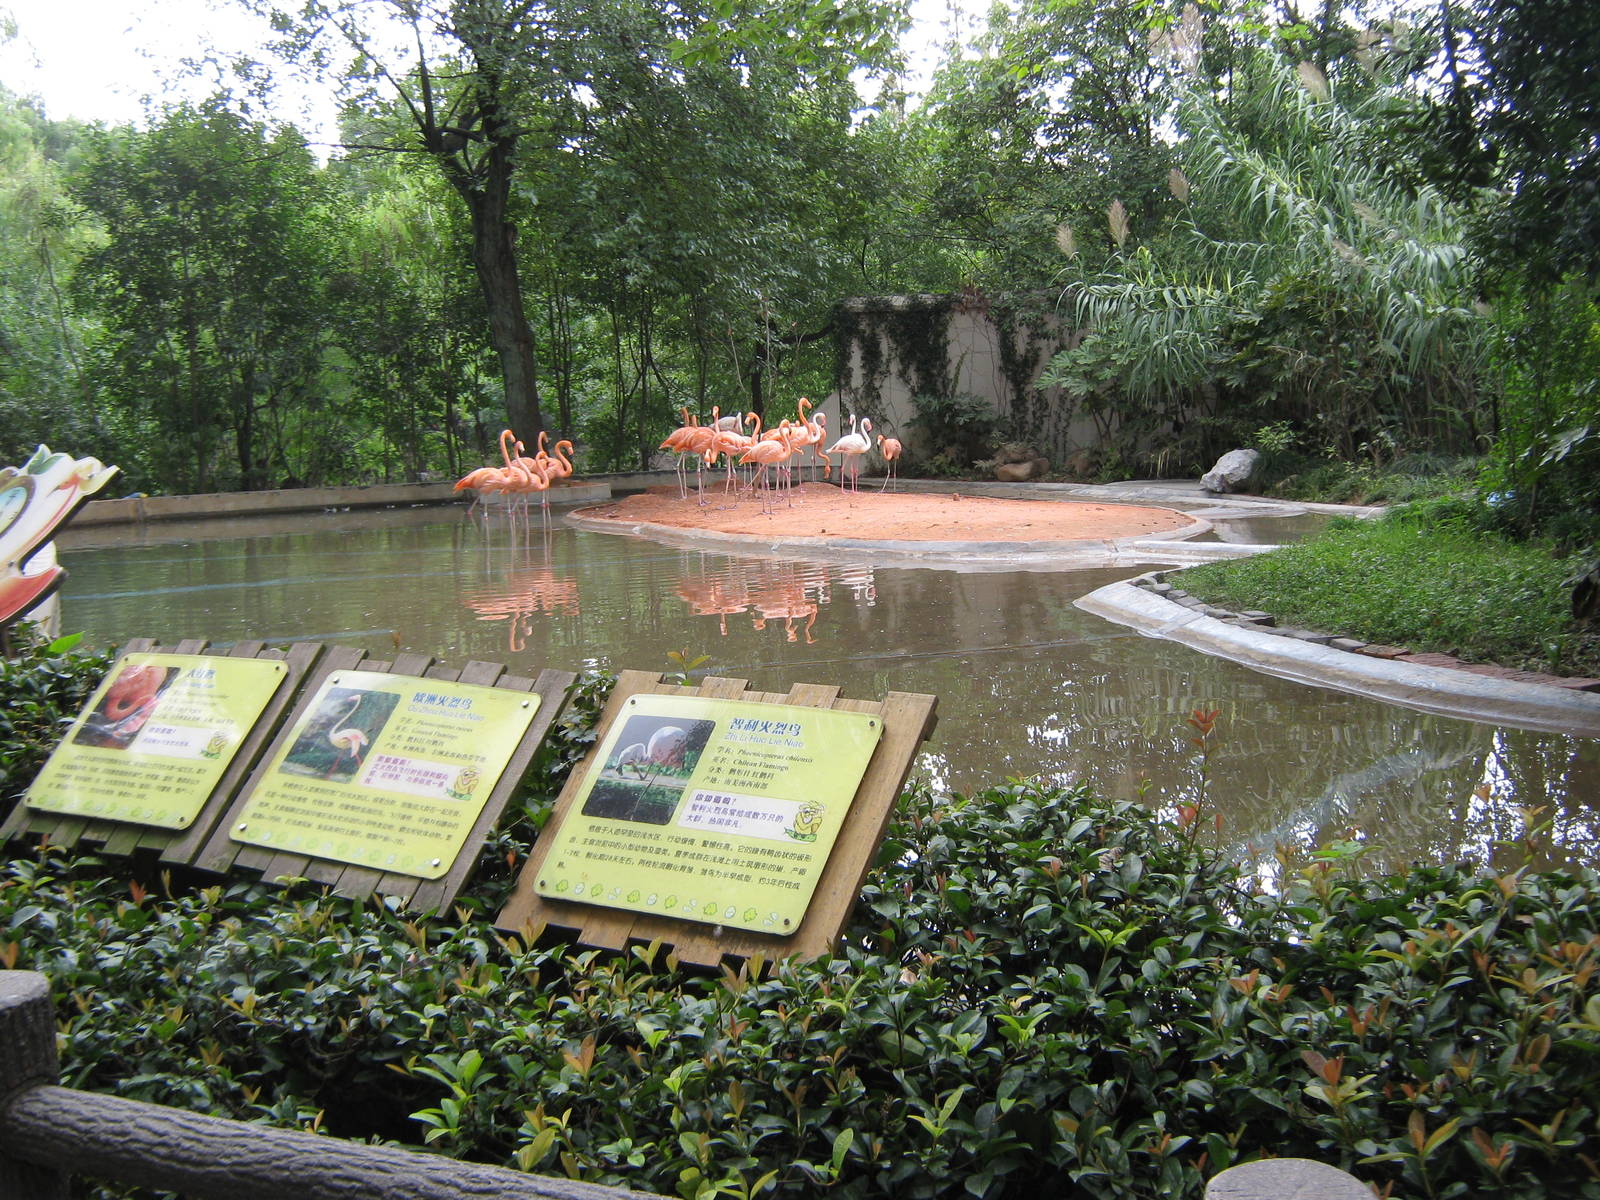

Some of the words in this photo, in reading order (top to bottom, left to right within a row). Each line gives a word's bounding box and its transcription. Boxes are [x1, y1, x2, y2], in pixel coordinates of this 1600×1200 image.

[412, 691, 473, 710] 欧洲火烈鸟
[730, 717, 802, 737] 智利火烈鸟
